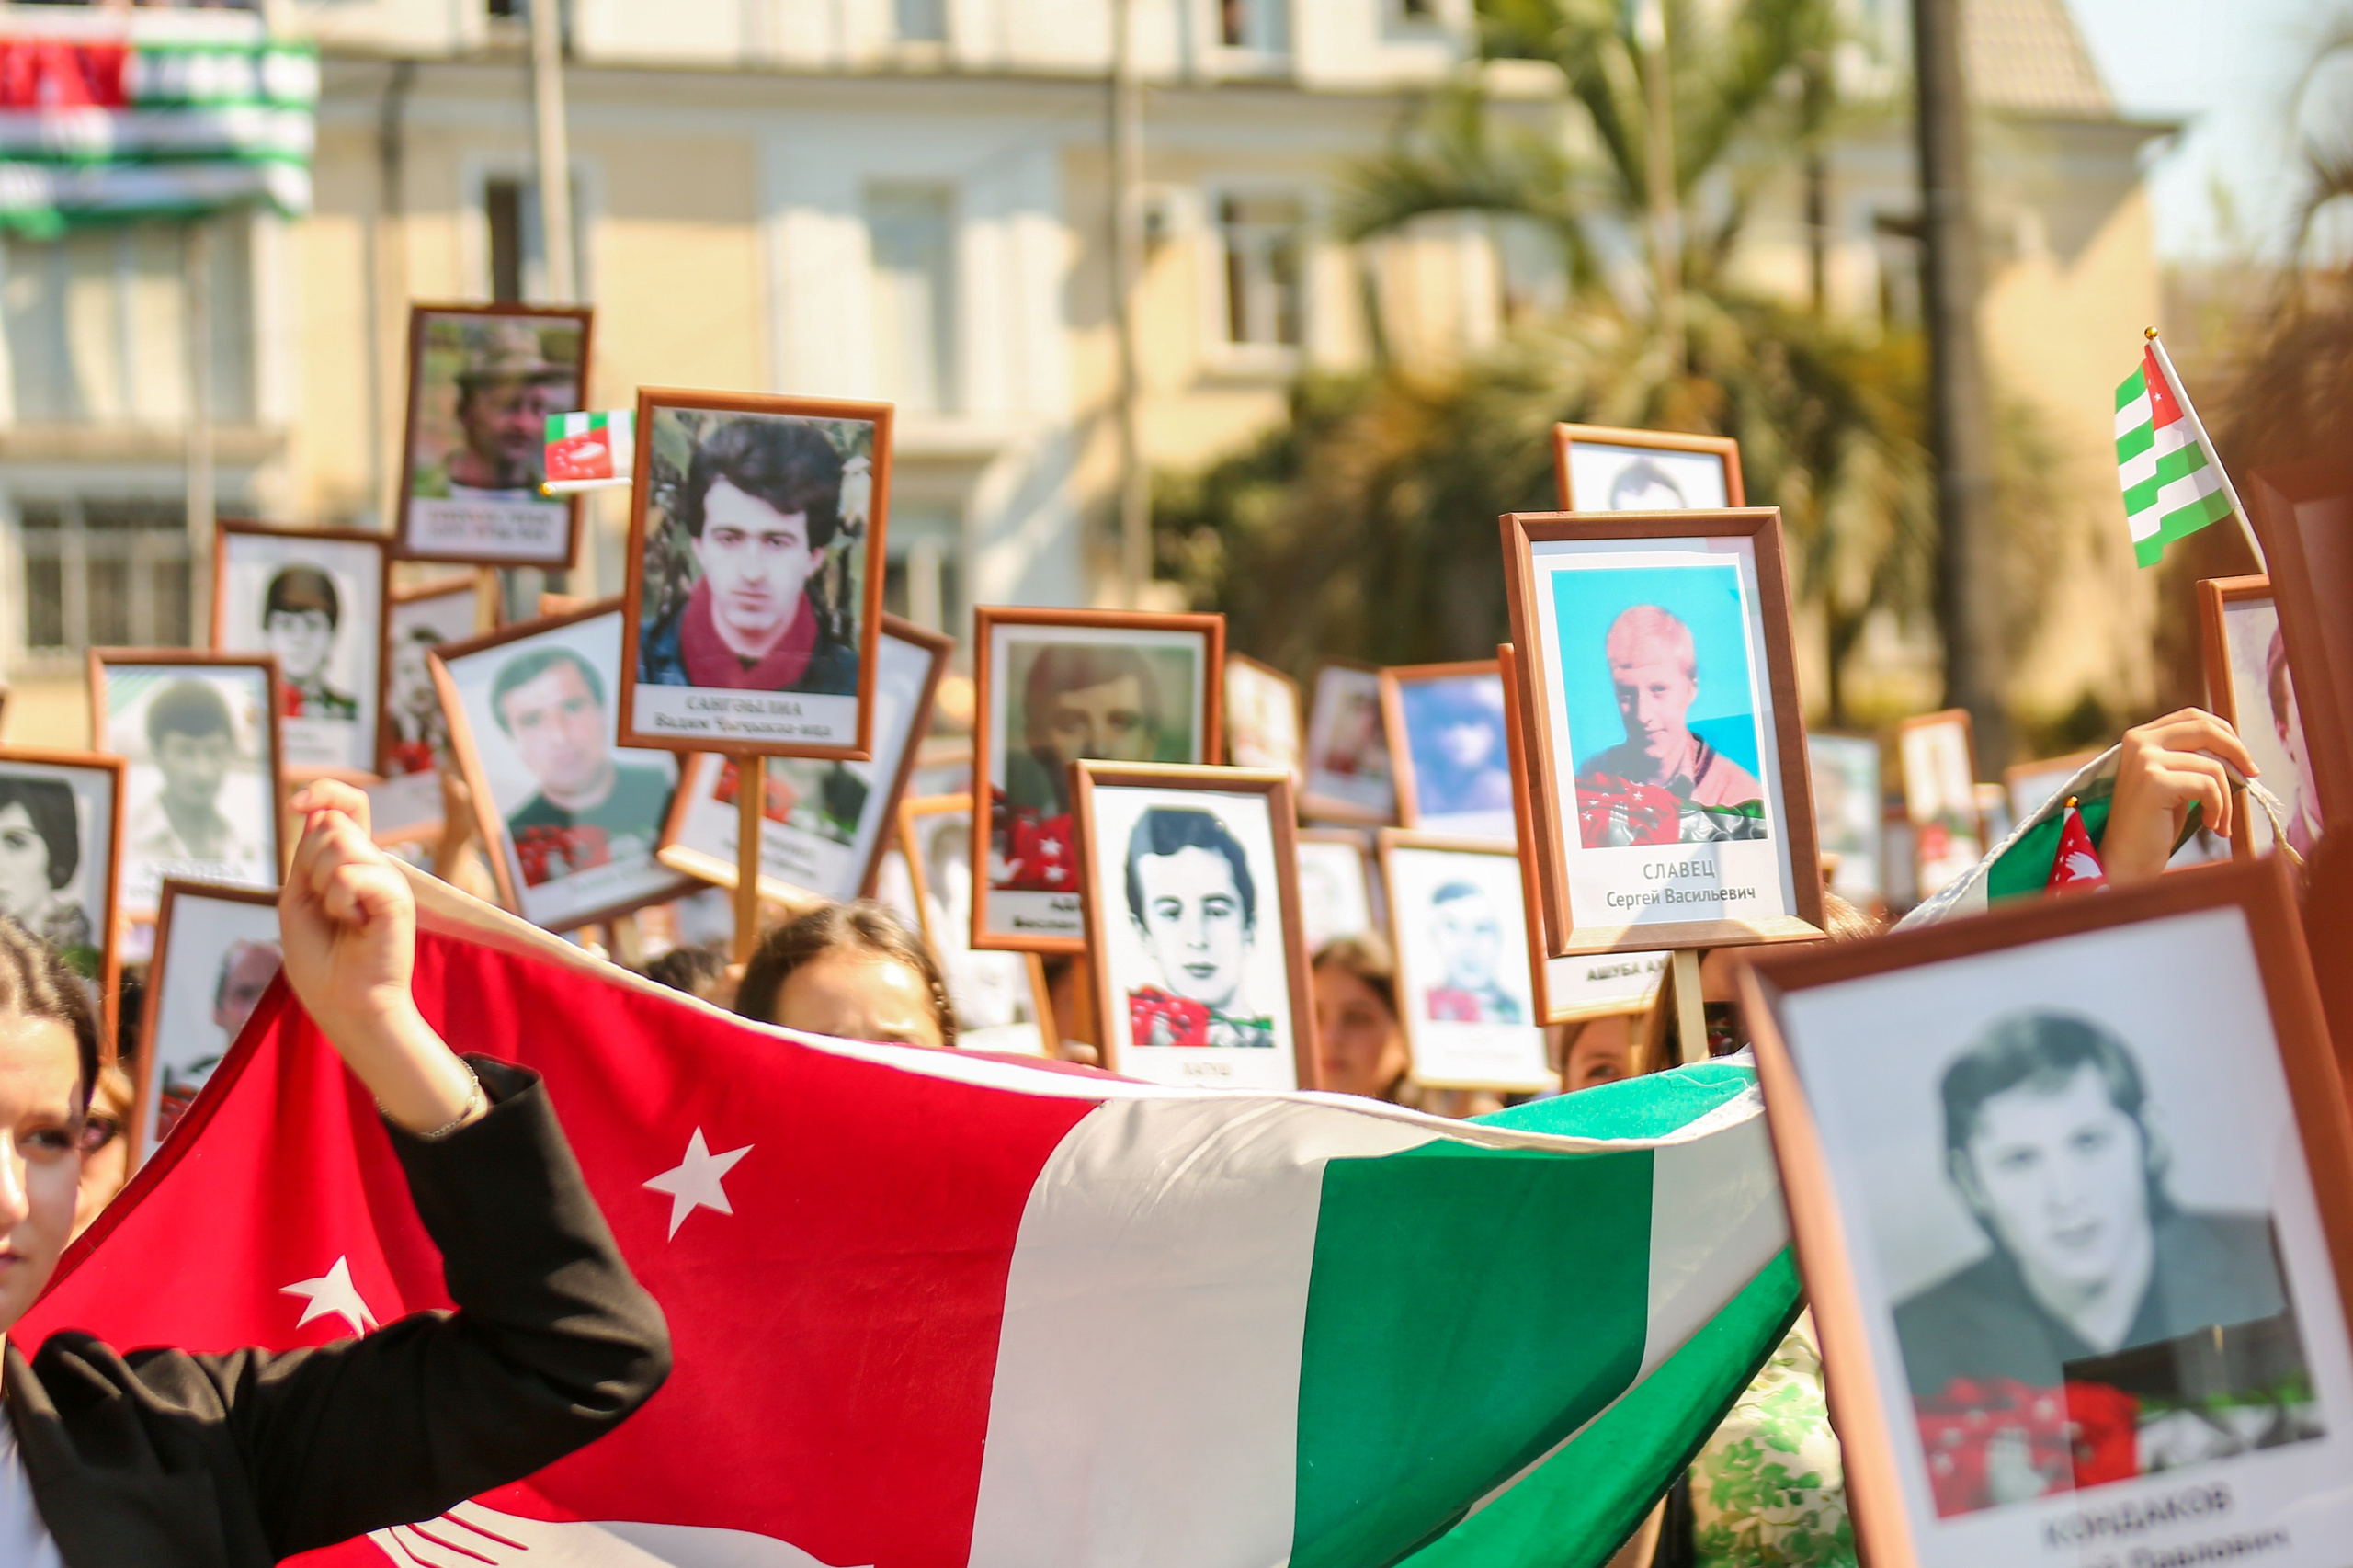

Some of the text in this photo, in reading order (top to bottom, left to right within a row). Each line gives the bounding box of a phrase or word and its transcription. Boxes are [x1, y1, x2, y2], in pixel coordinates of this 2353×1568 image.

[1643, 860, 1715, 880] СЛАВЕЦ
[1607, 887, 1756, 910] Сергей Васильевич
[1587, 962, 1640, 981] АШУБА
[2042, 1482, 2232, 1548] КОНДАКОВ
